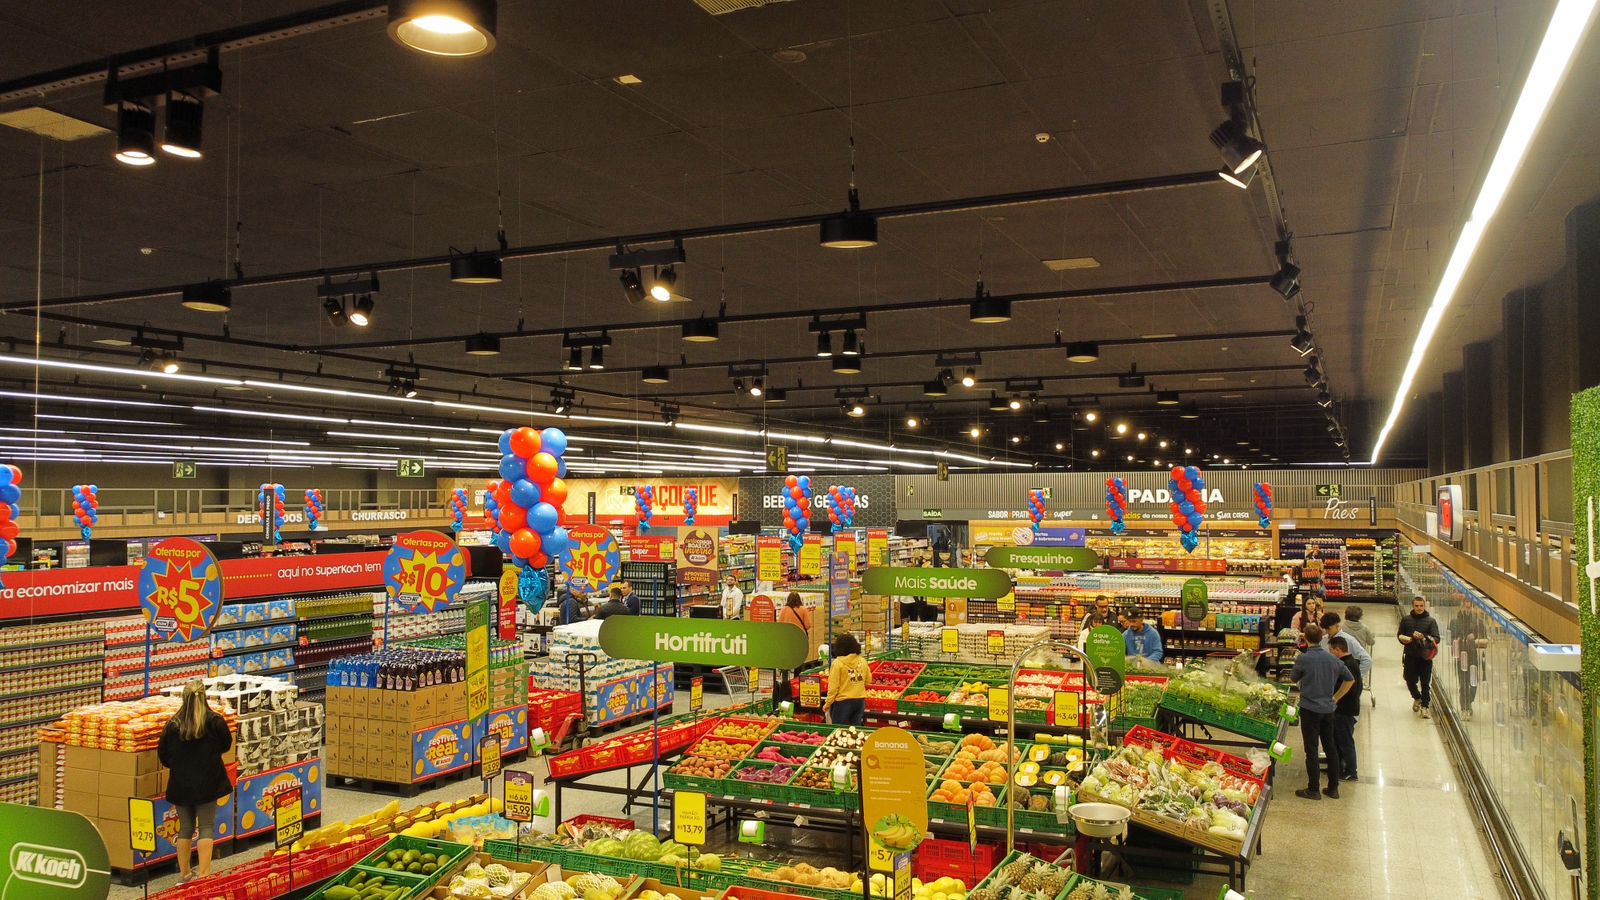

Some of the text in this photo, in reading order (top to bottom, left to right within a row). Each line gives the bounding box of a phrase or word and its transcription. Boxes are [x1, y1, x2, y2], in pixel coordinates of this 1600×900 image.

[651, 485, 718, 511] AÇOUUE
[814, 495, 869, 509] GEAS
[1128, 488, 1224, 504] PADIA
[237, 513, 303, 525] DEFDOS
[352, 511, 407, 521] CHURRASCO
[923, 509, 942, 517] SAÍDA
[988, 510, 1009, 519] SABOR
[1012, 510, 1047, 519] PRATIE
[571, 531, 605, 540] Ofertas por
[403, 538, 448, 549] Ofertas por
[155, 546, 201, 559] Ofertas por
[1010, 553, 1073, 565] Fresquinho
[277, 566, 299, 580] aqui
[301, 567, 314, 576] no
[365, 563, 382, 573] tem
[0, 578, 135, 599] ra economizar mais
[895, 575, 977, 590] Mais Saúde
[654, 631, 748, 656] Hortifrúti
[874, 741, 909, 749] Bananas
